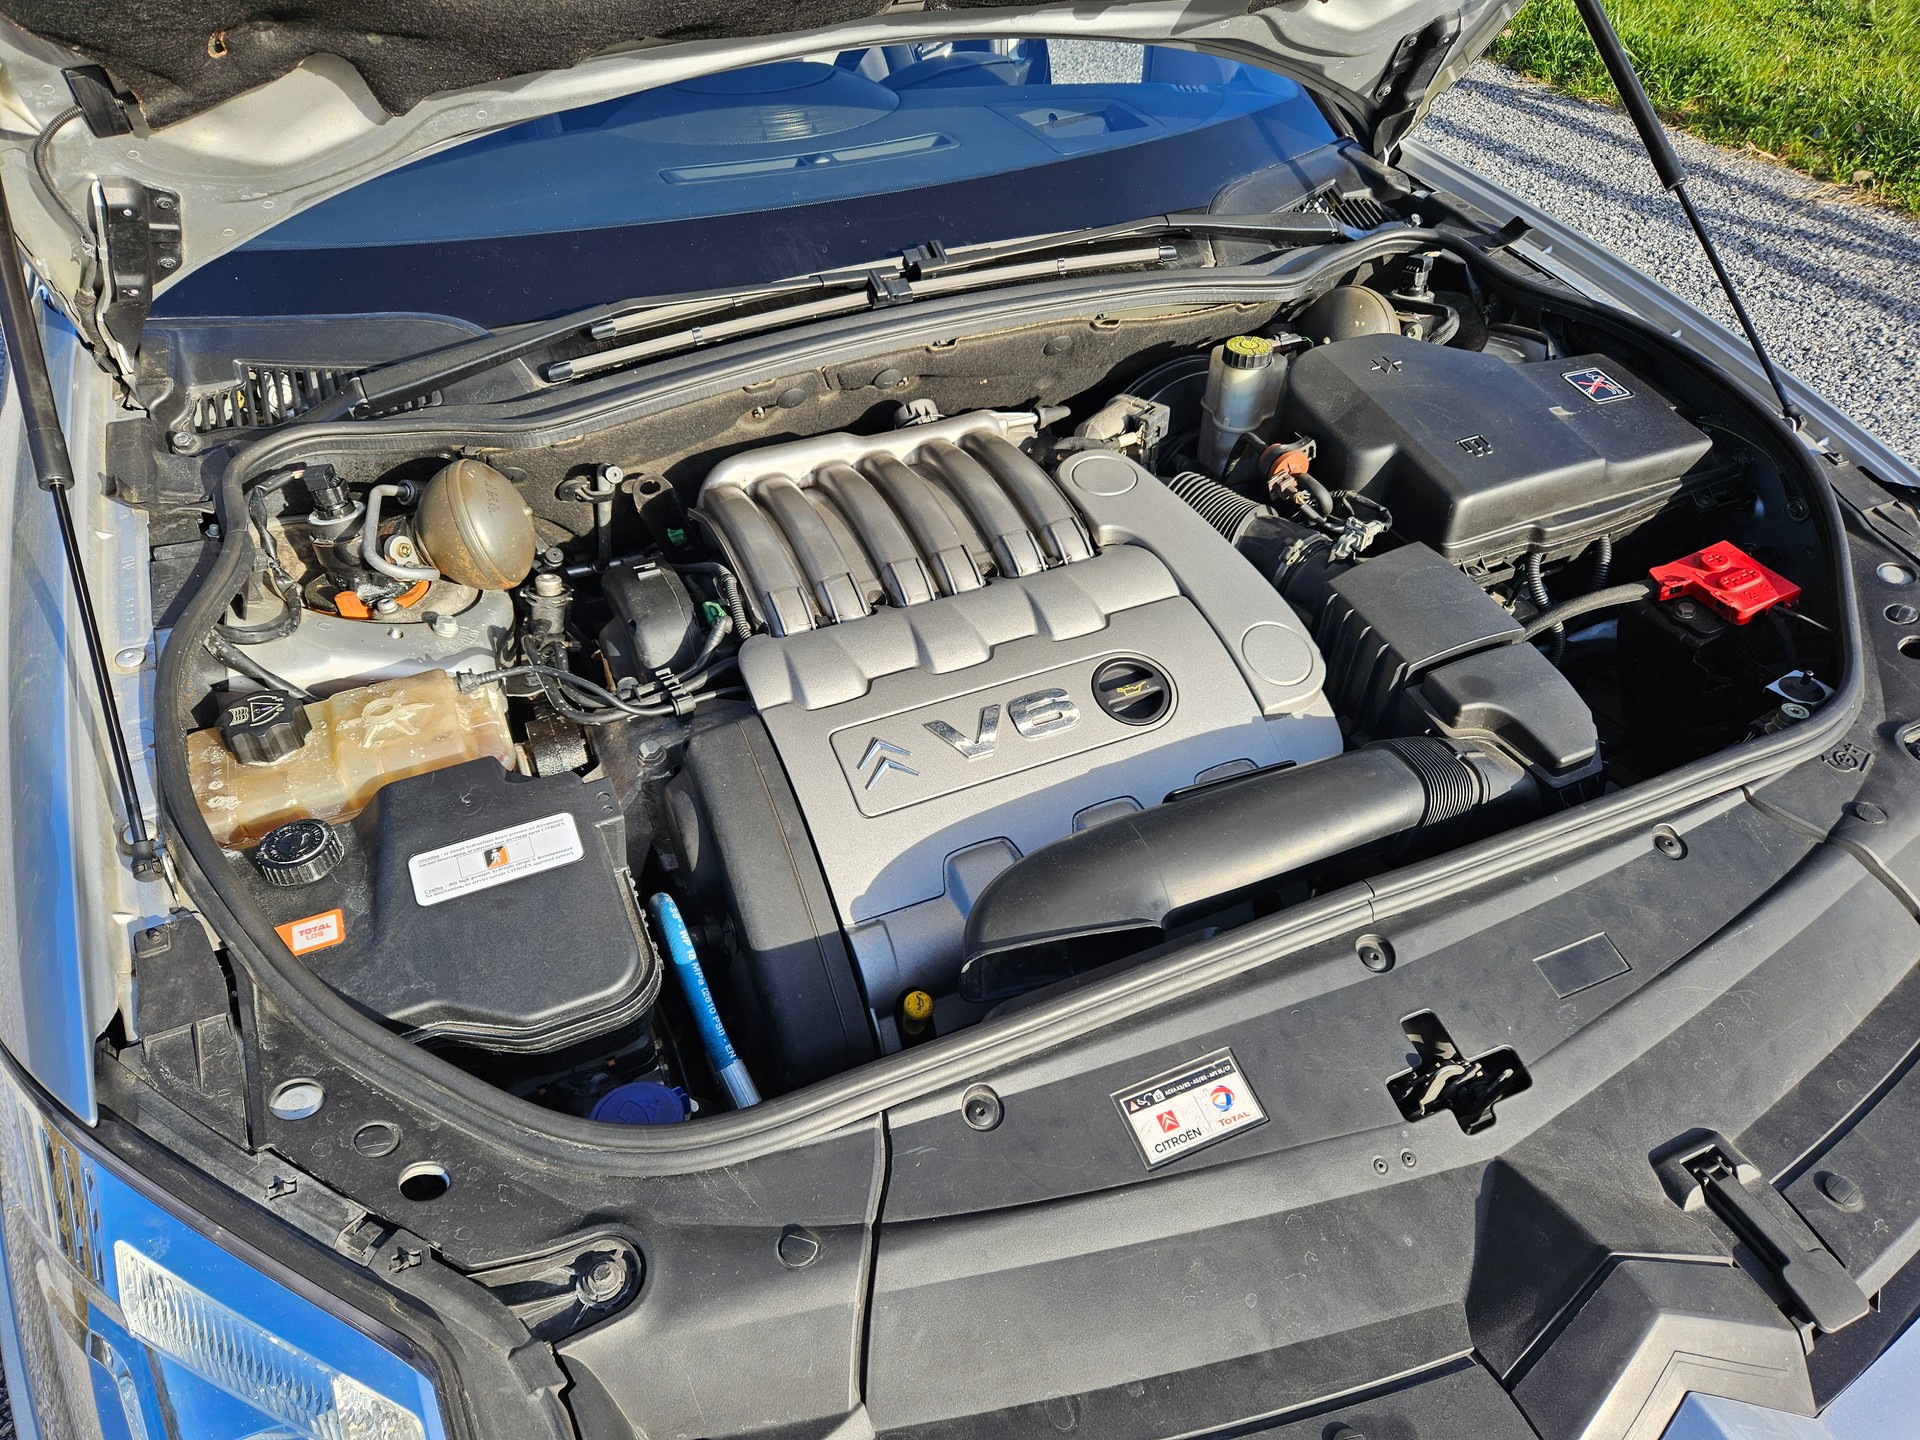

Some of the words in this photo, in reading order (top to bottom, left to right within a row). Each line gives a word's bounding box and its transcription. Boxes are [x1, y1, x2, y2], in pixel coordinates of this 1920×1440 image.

[922, 688, 1080, 759] V6
[298, 923, 331, 936] TOTAL
[306, 931, 324, 940] LDS
[680, 930, 692, 946] WP
[687, 949, 696, 960] 18
[692, 962, 704, 986] MPa
[712, 1016, 725, 1036] PSI)
[725, 1044, 736, 1058] EN
[1218, 1111, 1250, 1127] TOTAL
[1154, 1127, 1202, 1153] CITROËN
